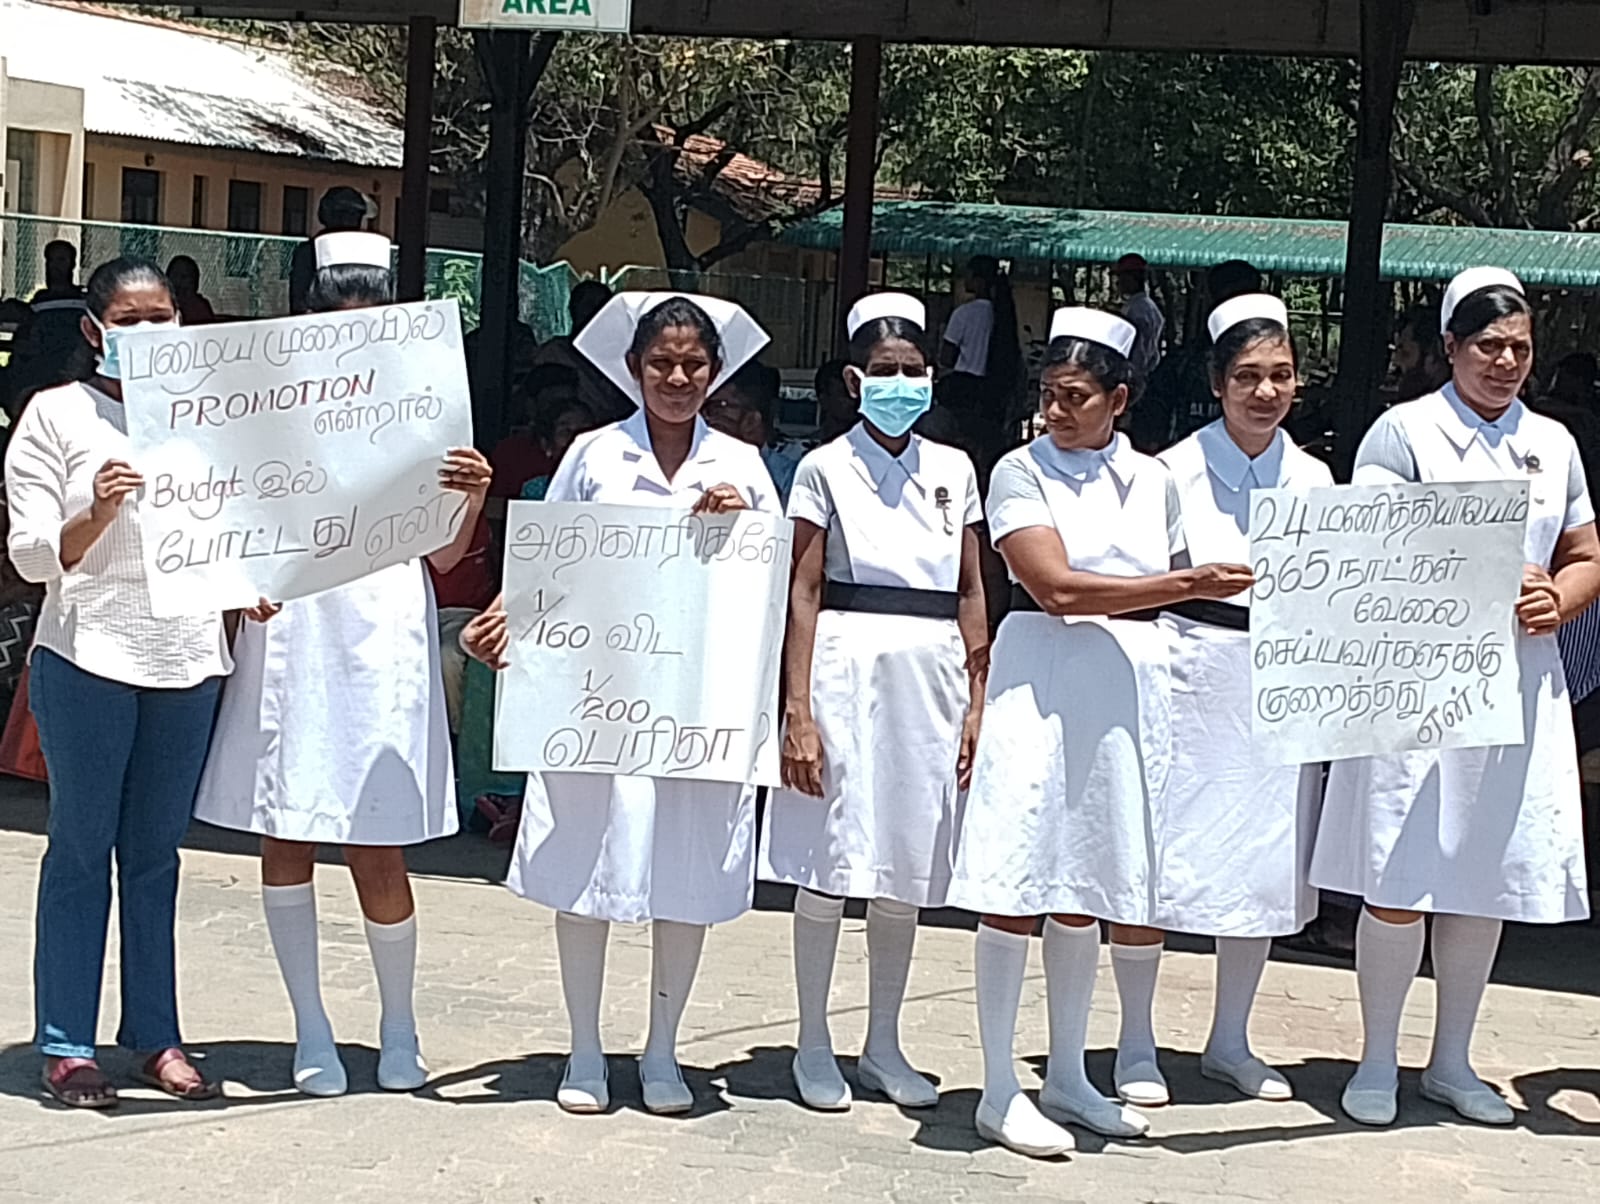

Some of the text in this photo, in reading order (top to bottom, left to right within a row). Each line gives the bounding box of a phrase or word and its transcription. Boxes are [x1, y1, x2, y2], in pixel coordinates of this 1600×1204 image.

[501, 0, 592, 16] AREA
[127, 305, 446, 395] பழைய முறையில்
[169, 368, 376, 430] PROMOTION
[313, 385, 443, 444] என்றால்
[252, 459, 328, 500] இல்
[1251, 496, 1311, 547] 24
[1353, 592, 1471, 628] வேலை
[605, 612, 684, 657] விட
